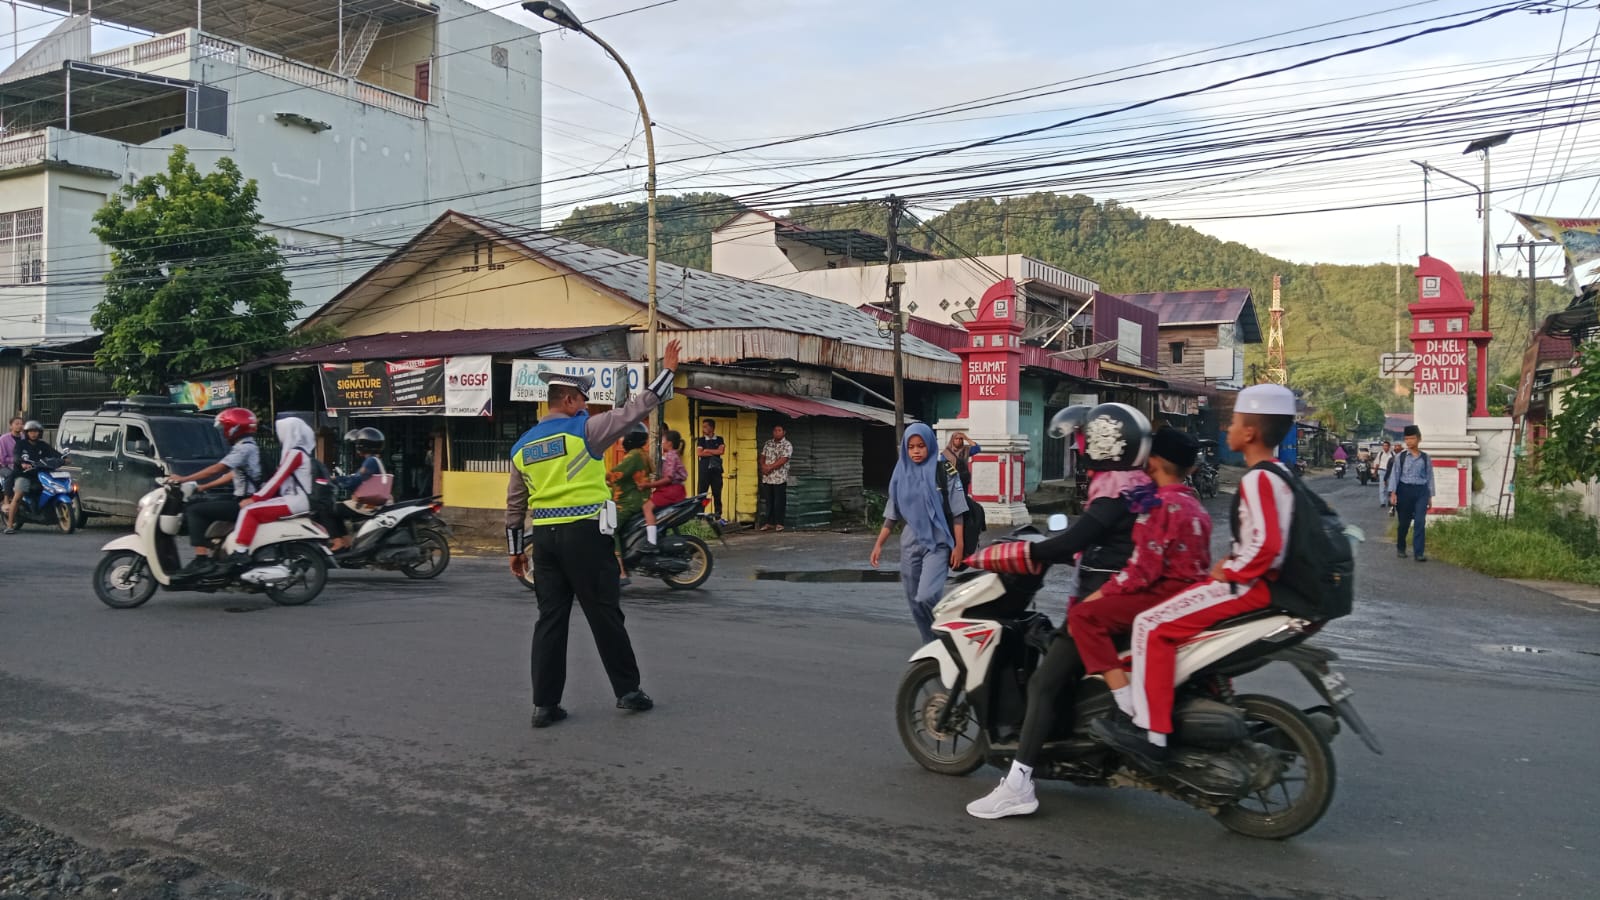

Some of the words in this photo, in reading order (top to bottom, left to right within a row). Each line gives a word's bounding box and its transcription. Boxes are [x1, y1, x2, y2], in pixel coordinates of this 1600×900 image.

[1427, 340, 1464, 352] DI-KEL.
[1415, 354, 1466, 366] PONDOK
[968, 361, 1007, 373] SELAMAT
[460, 373, 488, 386] GGSP
[969, 373, 1007, 385] DATANG
[1421, 368, 1459, 381] BATU
[337, 378, 381, 390] SIGNATURE
[1413, 381, 1467, 395] SARUDIK
[345, 391, 374, 399] KRETEK
[979, 385, 999, 396] KEC.
[524, 439, 564, 461] POLISI
